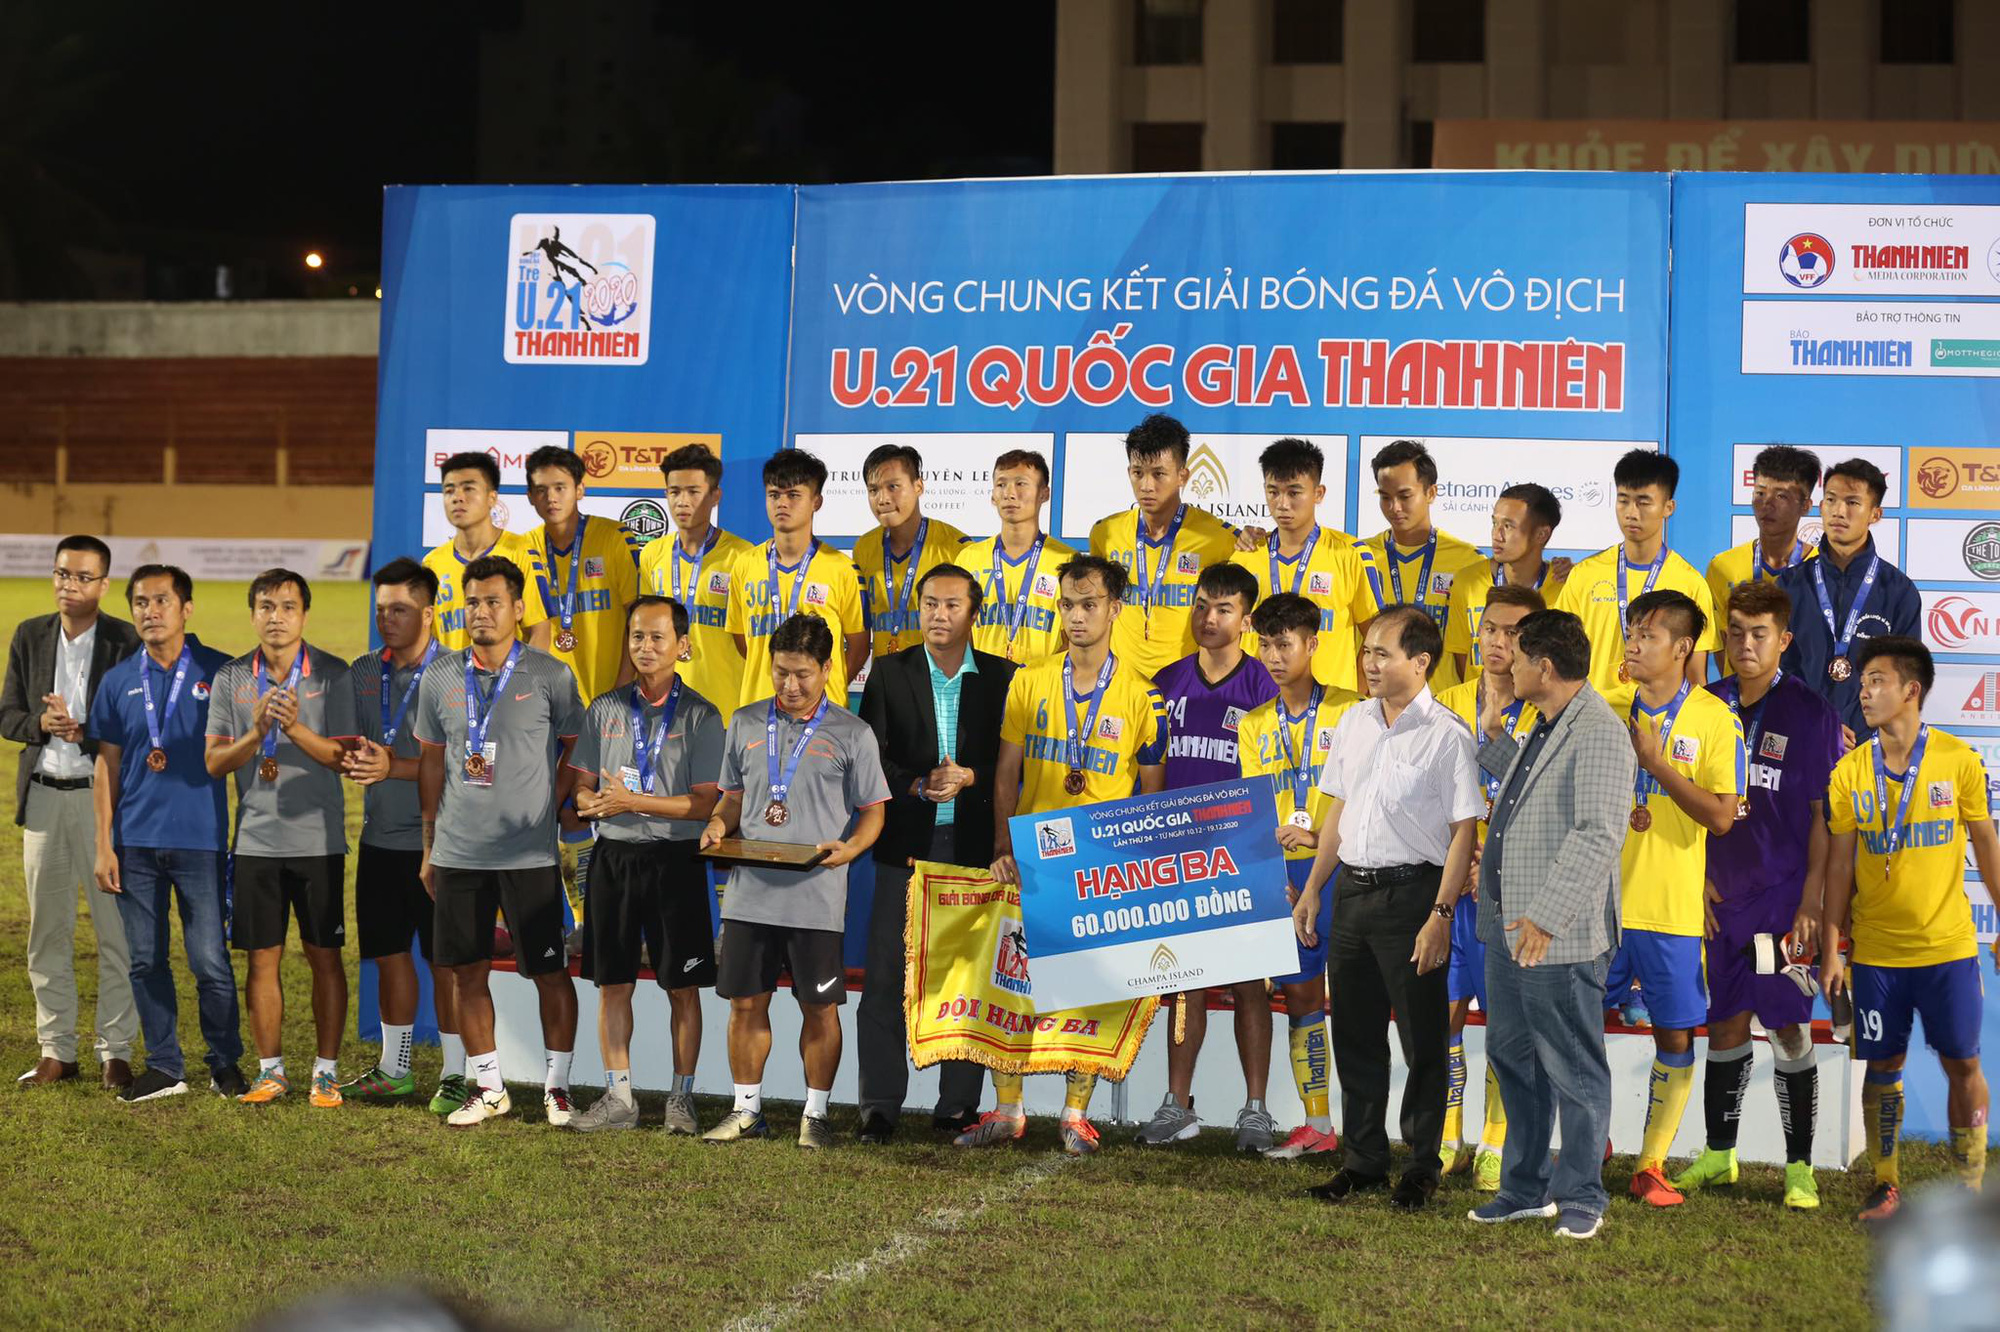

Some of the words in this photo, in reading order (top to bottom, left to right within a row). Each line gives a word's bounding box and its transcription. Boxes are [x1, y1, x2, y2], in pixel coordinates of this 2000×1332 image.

[1868, 217, 1892, 228] ĐƠN
[1799, 273, 1815, 281] VFF
[1868, 271, 1899, 281] MEDIA
[1900, 271, 1968, 281] CORPORATION
[833, 273, 944, 315] VÒNG
[953, 279, 1091, 312] CHUNG
[1102, 263, 1166, 311] KẾT
[1174, 267, 1248, 311] GIẢI
[1260, 267, 1378, 311] BÓNG
[1389, 267, 1444, 311] ĐÁ
[1453, 269, 1515, 311] VÔ
[1524, 278, 1625, 320] ĐỊCH
[516, 281, 581, 330] U.21
[1944, 313, 1961, 323] TIN
[830, 345, 958, 408] U.21
[967, 323, 1175, 411] QUỐC
[1182, 344, 1310, 408] GIA
[620, 446, 668, 464] T&T
[831, 471, 863, 481] TRU
[1436, 481, 1496, 498] etnam
[1036, 698, 1048, 731] 6
[1089, 809, 1114, 821] VÒNG
[1114, 804, 1145, 817] CHUNG
[1091, 823, 1120, 840] U.21
[1121, 812, 1165, 834] QUỐC
[1166, 812, 1192, 827] GIA
[1074, 859, 1183, 901] HẠNG
[1182, 846, 1239, 882] BA
[1071, 899, 1190, 939] 60.000.000
[1194, 887, 1253, 920] ĐỒNG
[1127, 973, 1167, 987] CHAMPA
[1170, 967, 1204, 980] ISLAND
[936, 994, 982, 1022] ĐỘI
[985, 1003, 1059, 1036] HẠNG
[1060, 1018, 1101, 1037] BA
[1859, 1008, 1884, 1042] 19
